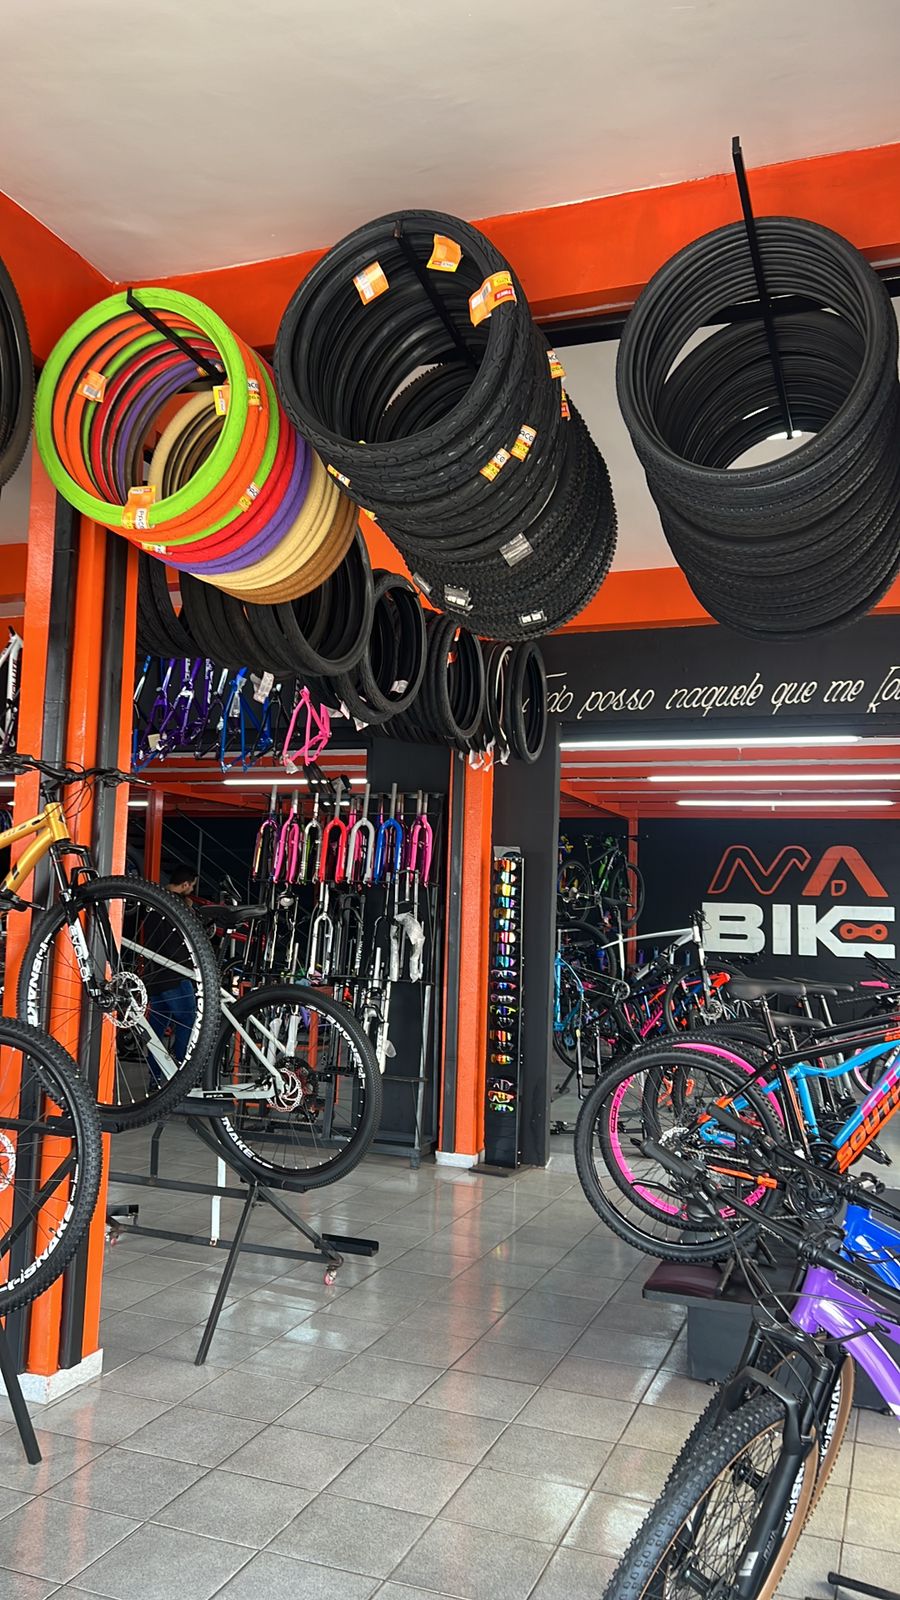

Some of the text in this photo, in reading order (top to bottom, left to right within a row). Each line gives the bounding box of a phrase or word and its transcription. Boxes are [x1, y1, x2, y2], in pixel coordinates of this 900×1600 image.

[577, 687, 655, 719] posso
[665, 672, 763, 717] naquele
[771, 681, 818, 715] que
[823, 679, 865, 703] me
[702, 902, 896, 959] BIKE
